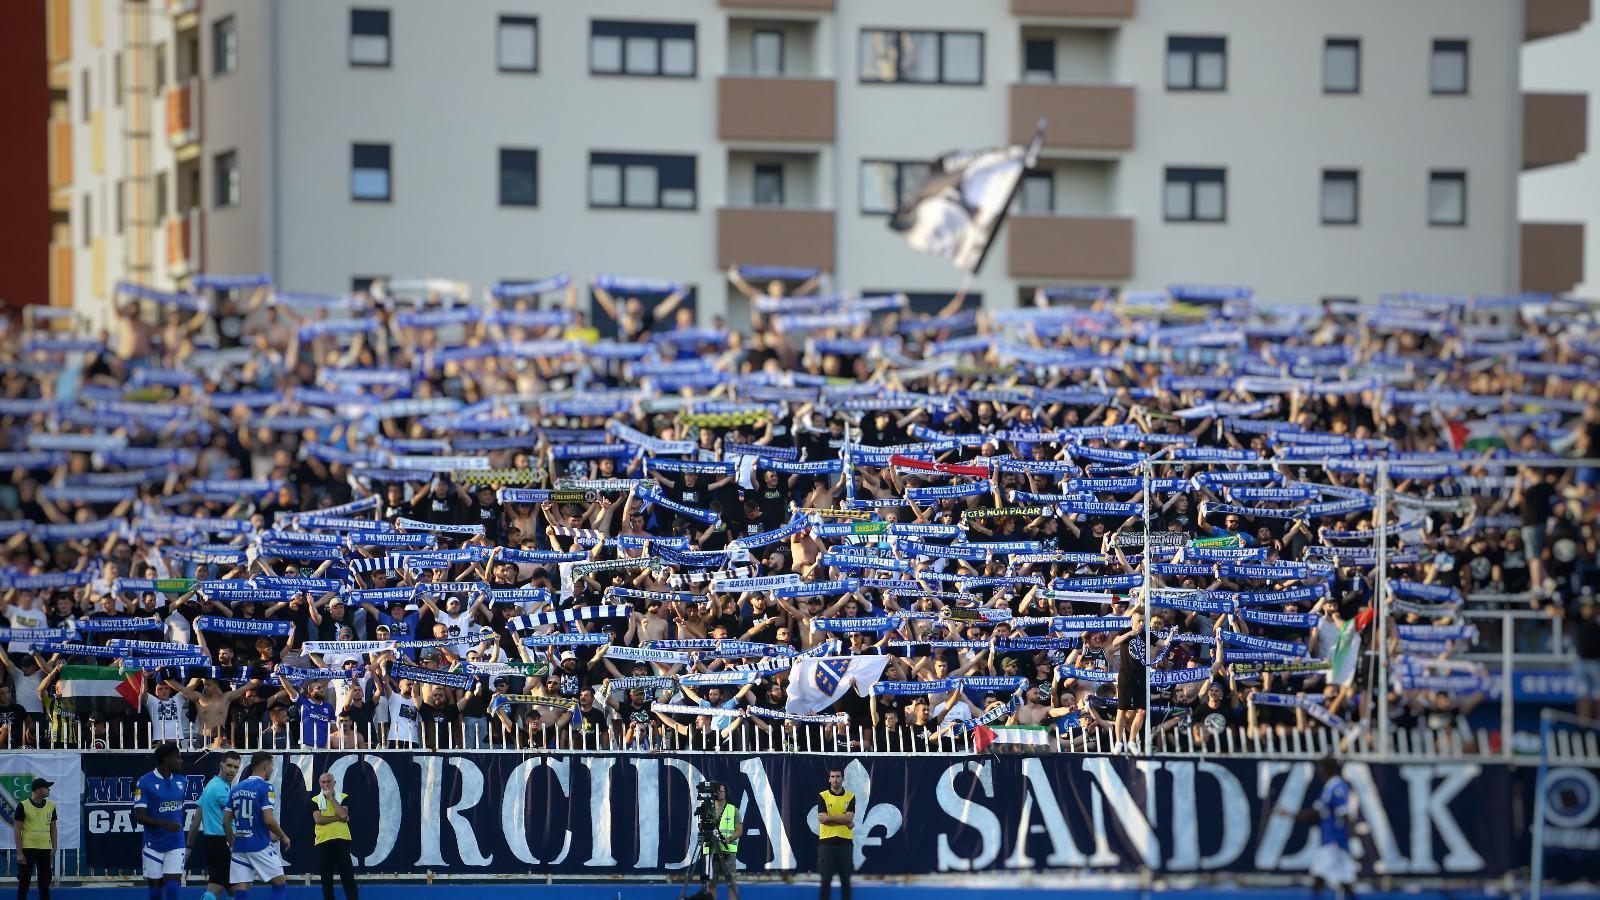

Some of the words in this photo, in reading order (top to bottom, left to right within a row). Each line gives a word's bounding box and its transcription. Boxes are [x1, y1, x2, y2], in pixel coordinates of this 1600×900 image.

[924, 442, 954, 450] PAZAR
[1090, 448, 1109, 456] NOVI
[1110, 450, 1134, 460] PAZAR
[864, 455, 874, 463] FK
[784, 462, 802, 470] NOVI
[1211, 473, 1221, 481] FK
[1223, 472, 1242, 480] NOVI
[1244, 471, 1269, 480] PAZAR
[1081, 479, 1092, 487] FK
[1093, 479, 1110, 487] NOVI
[1113, 478, 1137, 487] PAZAR
[933, 487, 950, 495] NOVI
[952, 483, 976, 492] PAZAR
[1245, 489, 1256, 497] FK
[1257, 489, 1276, 497] NOVI
[1278, 489, 1305, 497] PAZAR
[1028, 493, 1038, 501] FK
[650, 491, 660, 501] FK
[661, 496, 681, 508] NOVI
[680, 502, 705, 517] PAZAR
[1085, 503, 1103, 511] NOVI
[967, 509, 985, 518] GFB
[987, 508, 1007, 516] NOVI
[1010, 507, 1040, 515] PAZAR
[326, 519, 346, 527] NOVI
[348, 521, 375, 529] PAZAR
[409, 522, 433, 530] NOVI
[931, 525, 956, 534] PAZAR
[275, 532, 285, 540] FK
[287, 533, 307, 541] NOVI
[308, 534, 337, 542] PAZAR
[377, 534, 396, 542] NOVI
[924, 544, 944, 553] NOVI
[946, 547, 971, 555] PAZAR
[1234, 549, 1258, 557] PAZAR
[847, 556, 866, 564] NOVI
[869, 558, 894, 567] PAZAR
[1065, 554, 1096, 562] FENER
[1234, 567, 1246, 575] FK
[1247, 567, 1265, 576] NOVI
[1267, 569, 1293, 577] PAZAR
[282, 578, 300, 586] NOVI
[301, 579, 327, 587] PAZAR
[818, 580, 842, 590] PAZAR
[232, 590, 252, 598] NOVI
[254, 590, 281, 598] PAZAR
[1267, 592, 1284, 600] NOVI
[1286, 588, 1311, 598] PAZAR
[1173, 600, 1191, 608] NOVI
[1193, 601, 1218, 609] PAZAR
[1246, 611, 1256, 619] FK
[1258, 613, 1277, 621] NOVI
[1279, 614, 1304, 622] PAZAR
[89, 619, 100, 627] FK
[123, 618, 149, 627] PAZAR
[213, 619, 224, 627] FK
[226, 620, 245, 629] NOVI
[247, 621, 273, 630] PAZAR
[841, 620, 860, 628] NOVI
[862, 619, 886, 627] PAZAR
[1066, 620, 1085, 628] NIKAD
[12, 629, 32, 637] NOVI
[34, 630, 61, 638] PAZAR
[564, 634, 598, 642] PAZAR
[63, 643, 84, 651] NOVI
[138, 641, 159, 649] NOVI
[1235, 634, 1246, 642] FK
[1247, 637, 1266, 646] NOVI
[1267, 641, 1294, 651] PAZAR
[152, 659, 172, 667] NOVI
[922, 681, 946, 690] PAZAR
[968, 678, 988, 686] NOVI
[990, 678, 1014, 686] PAZAR
[233, 754, 797, 870] TORCIDA
[935, 757, 1485, 873] SANDZAK
